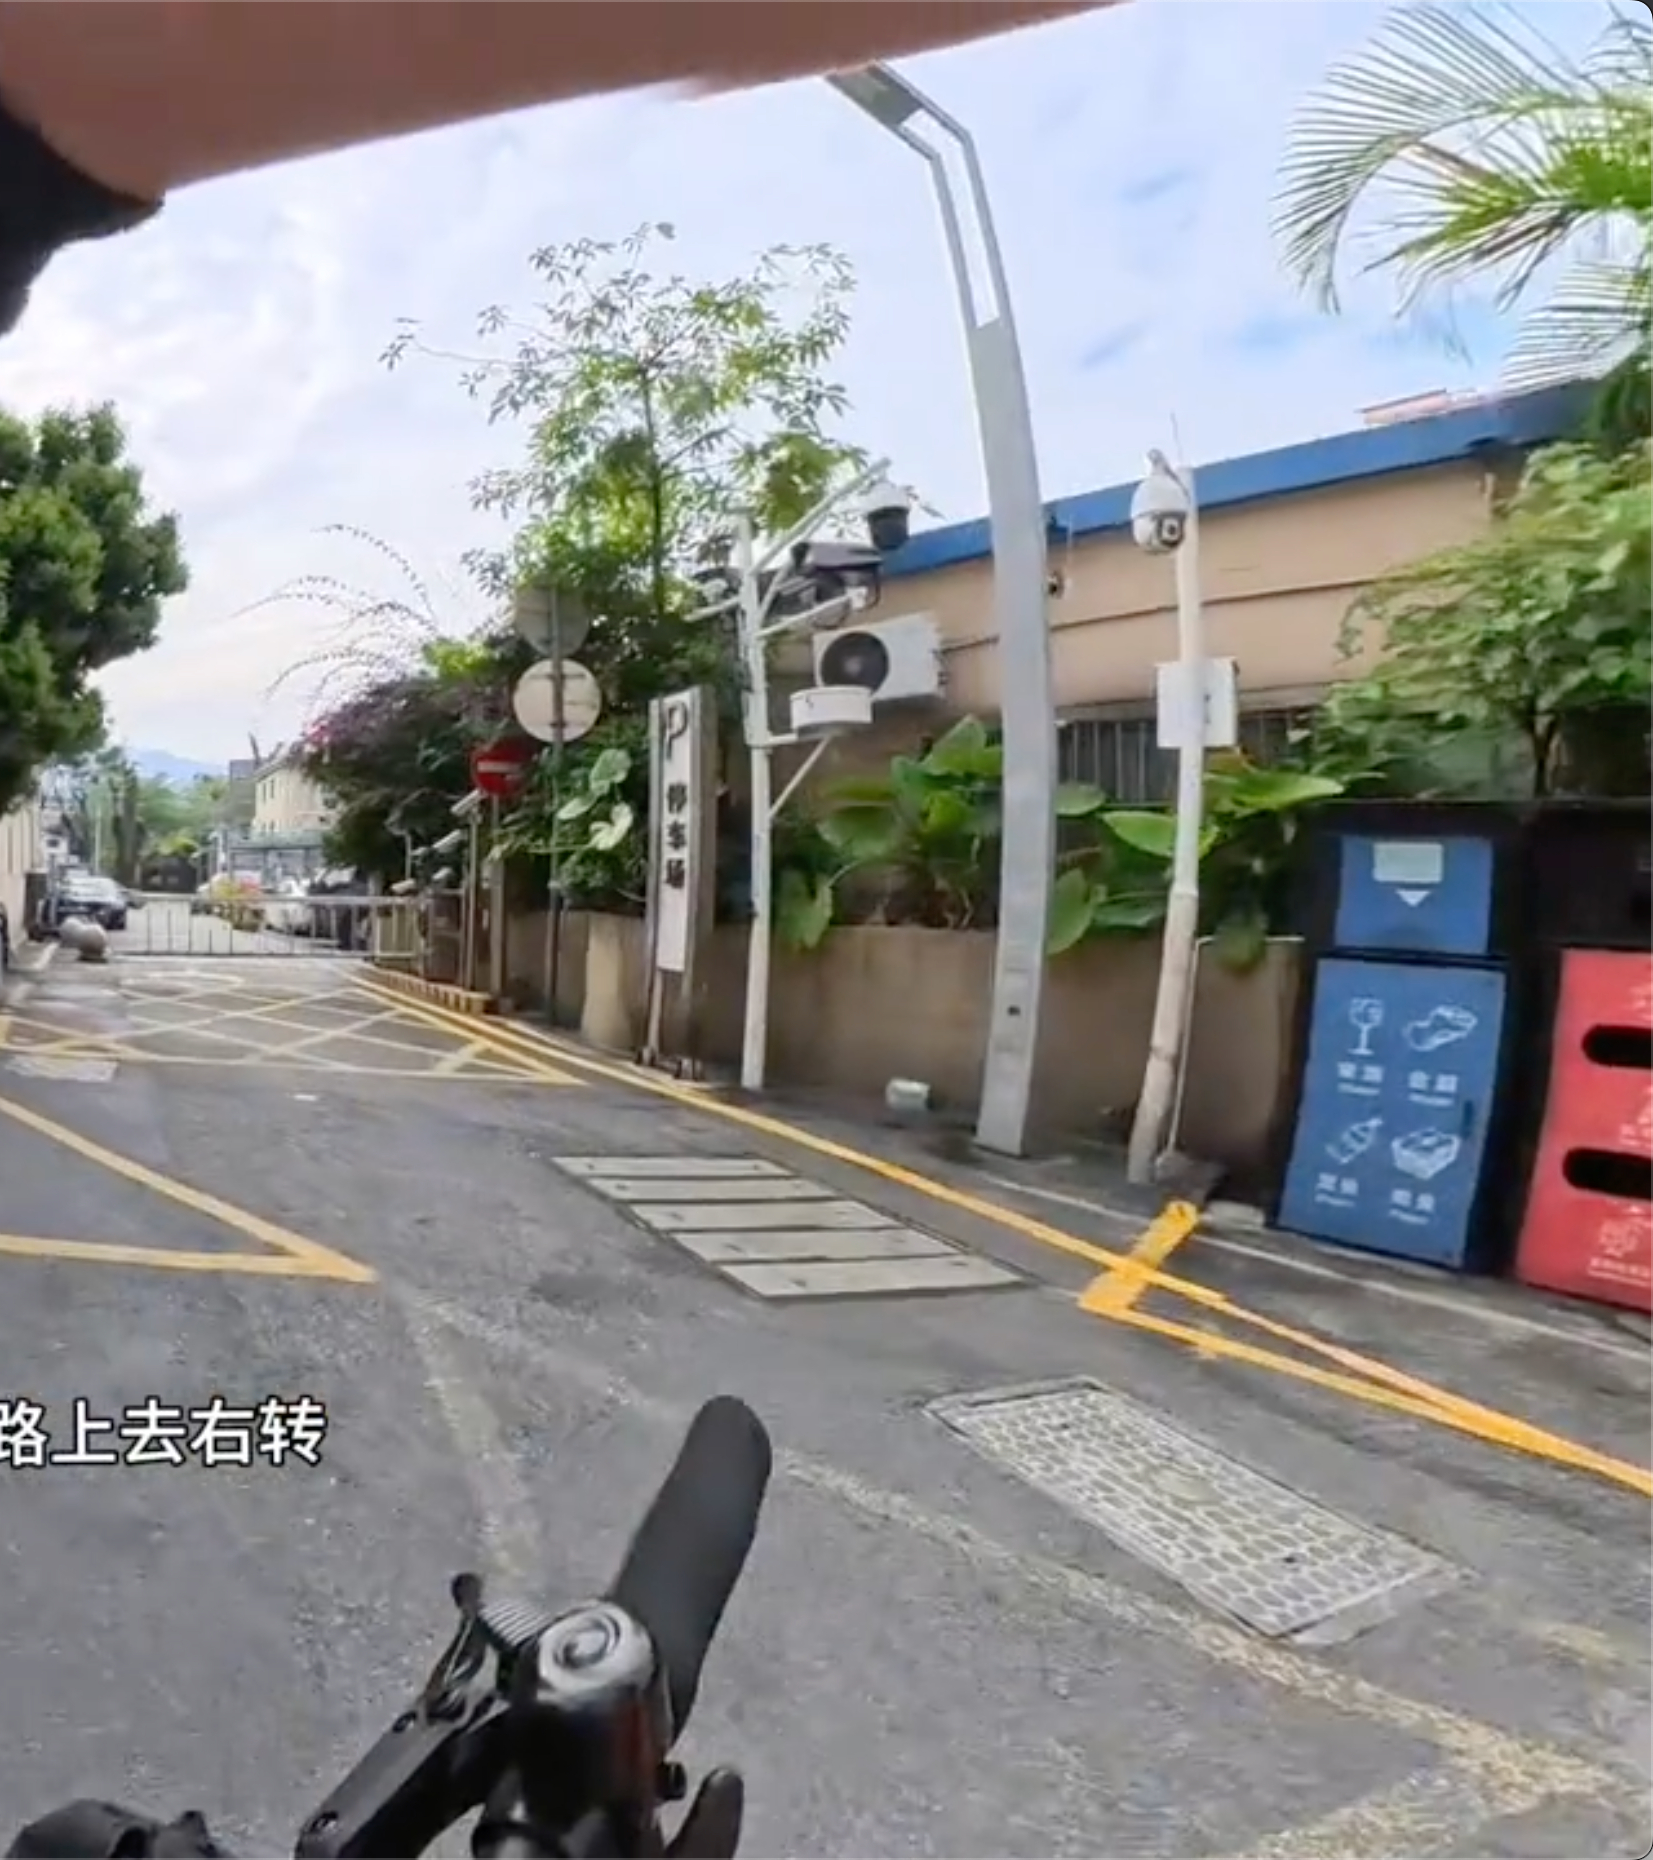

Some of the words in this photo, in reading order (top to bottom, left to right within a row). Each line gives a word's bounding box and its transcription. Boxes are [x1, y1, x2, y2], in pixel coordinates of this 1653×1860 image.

[664, 699, 688, 759] P
[664, 783, 688, 890] 停车场
